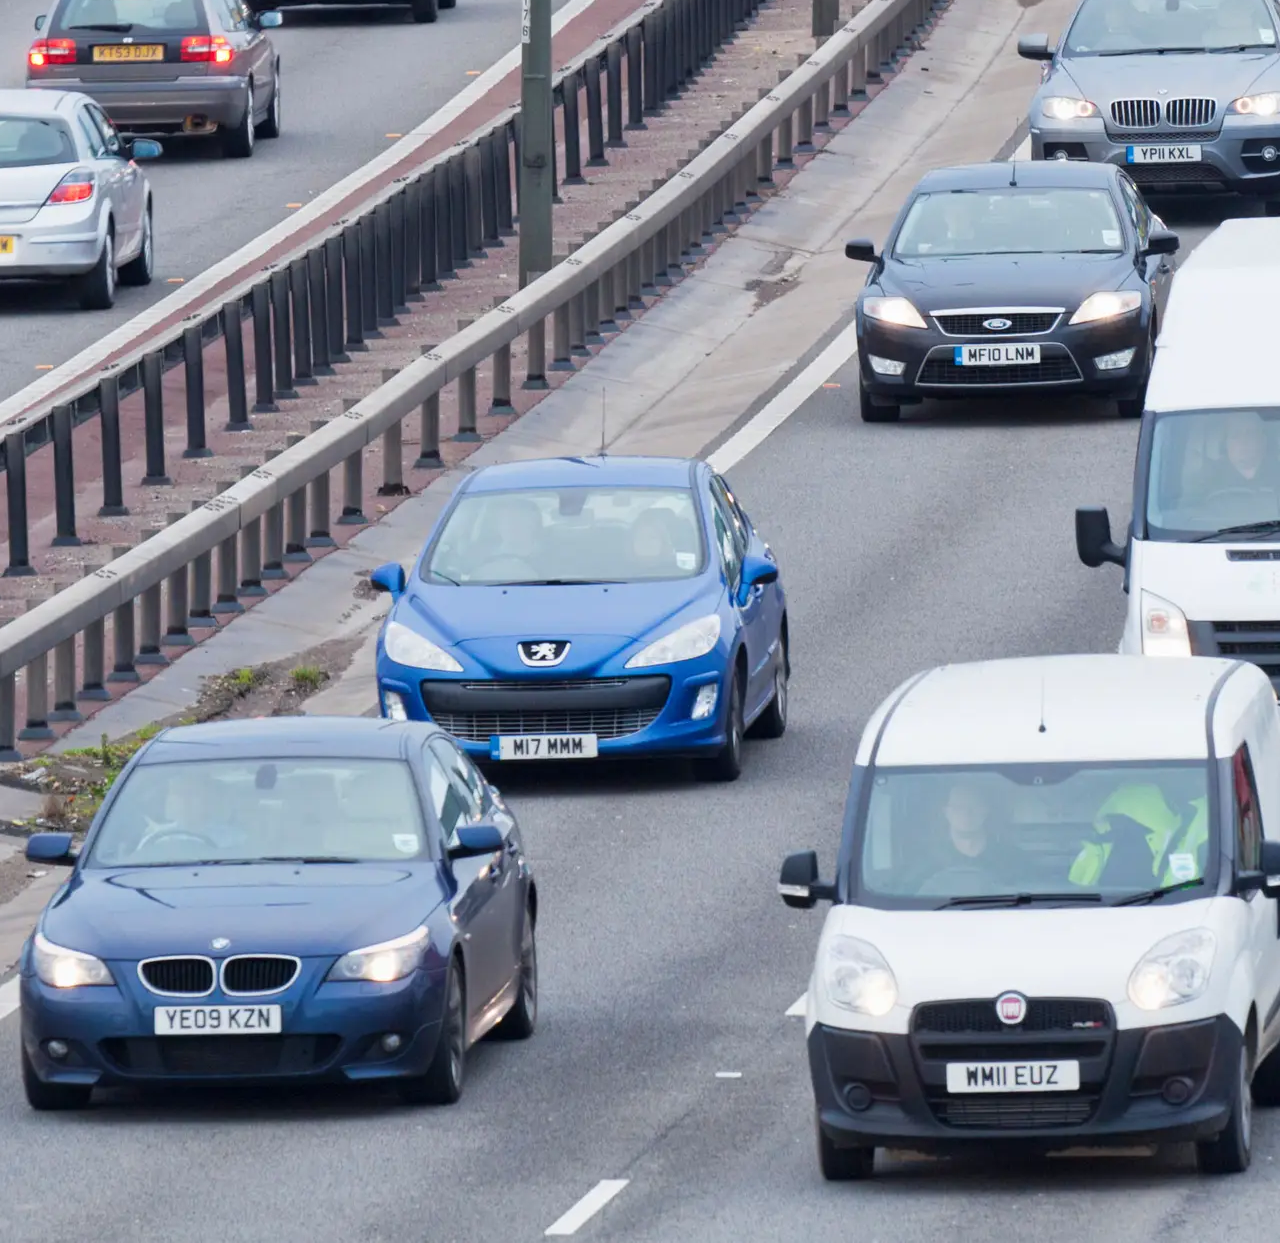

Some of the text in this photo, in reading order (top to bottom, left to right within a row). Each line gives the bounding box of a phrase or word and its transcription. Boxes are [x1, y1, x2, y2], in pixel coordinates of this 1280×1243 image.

[1141, 147, 1194, 160] YP11 KXL
[968, 347, 1035, 362] MF10 LNM
[513, 737, 583, 755] M17 MMM
[166, 1008, 270, 1029] YE09 KZN
[966, 1064, 1059, 1087] WM11 EUZ
